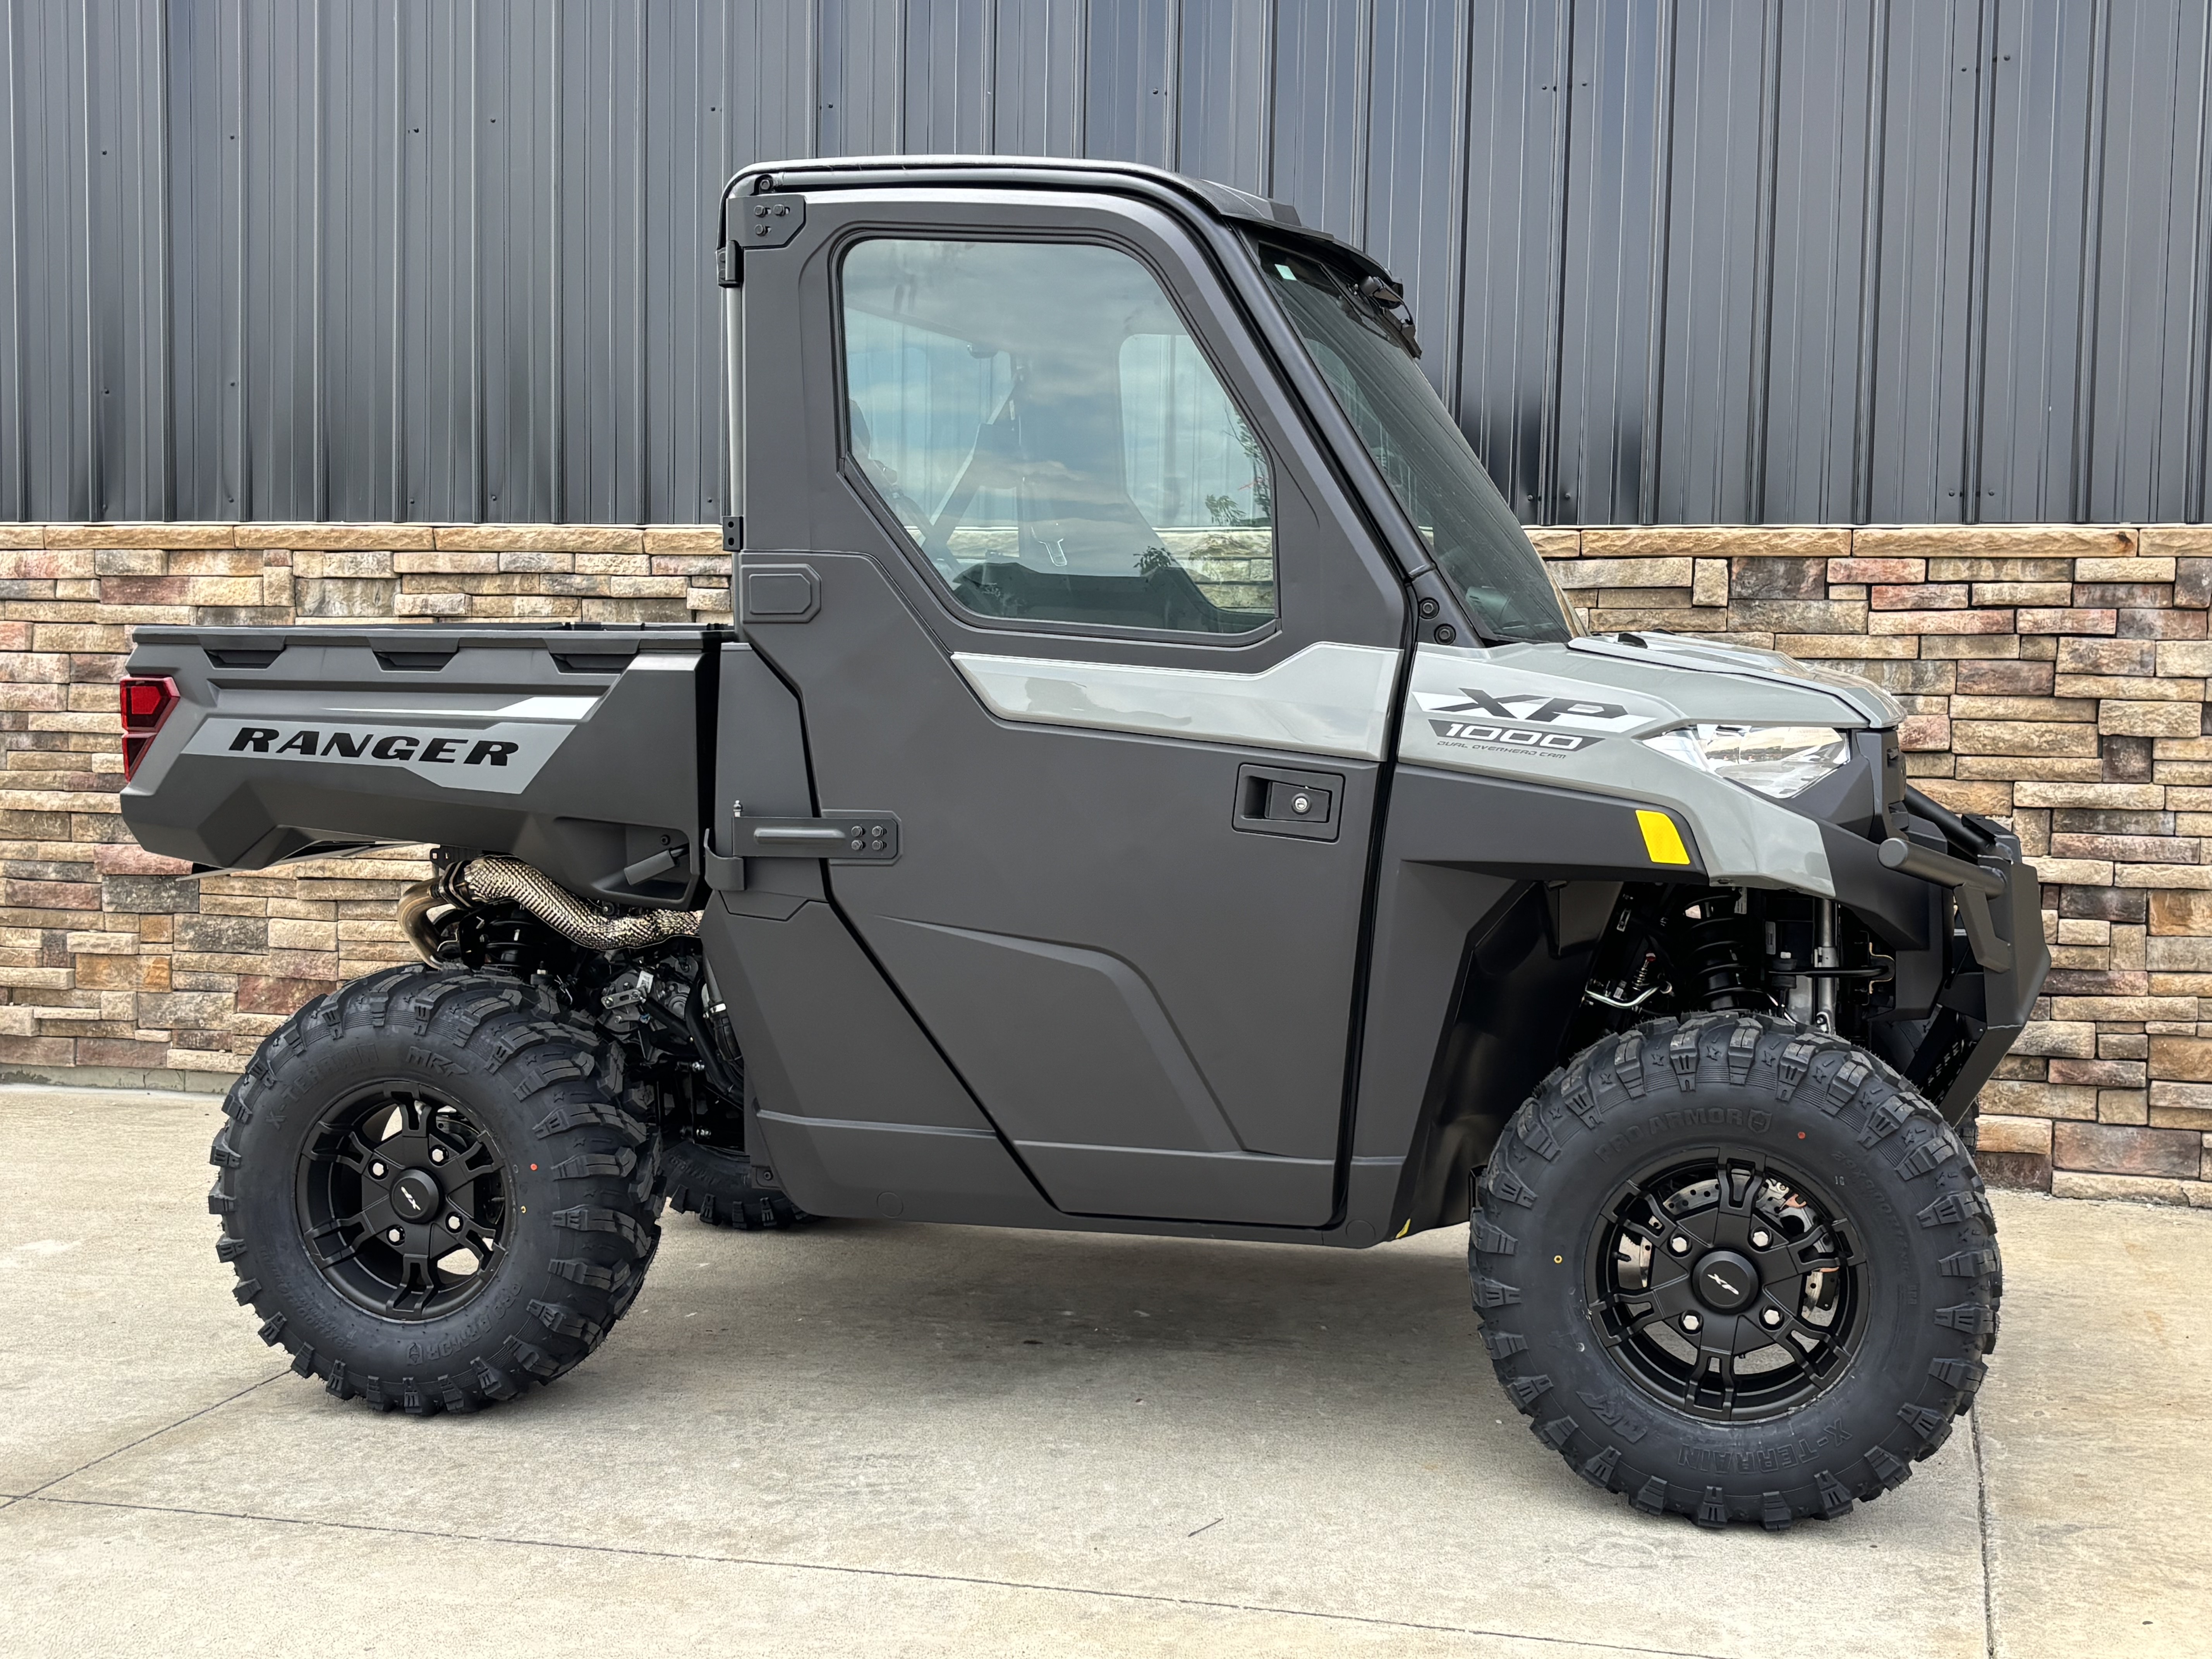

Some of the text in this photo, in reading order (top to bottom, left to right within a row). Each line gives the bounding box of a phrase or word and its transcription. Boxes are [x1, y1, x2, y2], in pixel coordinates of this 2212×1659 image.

[1429, 688, 1628, 722] XP
[228, 726, 520, 766] RANGER
[1444, 723, 1583, 750] 1000
[1472, 744, 1537, 756] OVERHEAD
[265, 1043, 379, 1130] X-TERRAIN
[1594, 1107, 1743, 1163] PRO ARMOR
[401, 1187, 421, 1210] XP
[1707, 1273, 1739, 1295] XP
[427, 1282, 522, 1361] PRO ARMOR
[1677, 1417, 1853, 1473] X-TERRAIN
